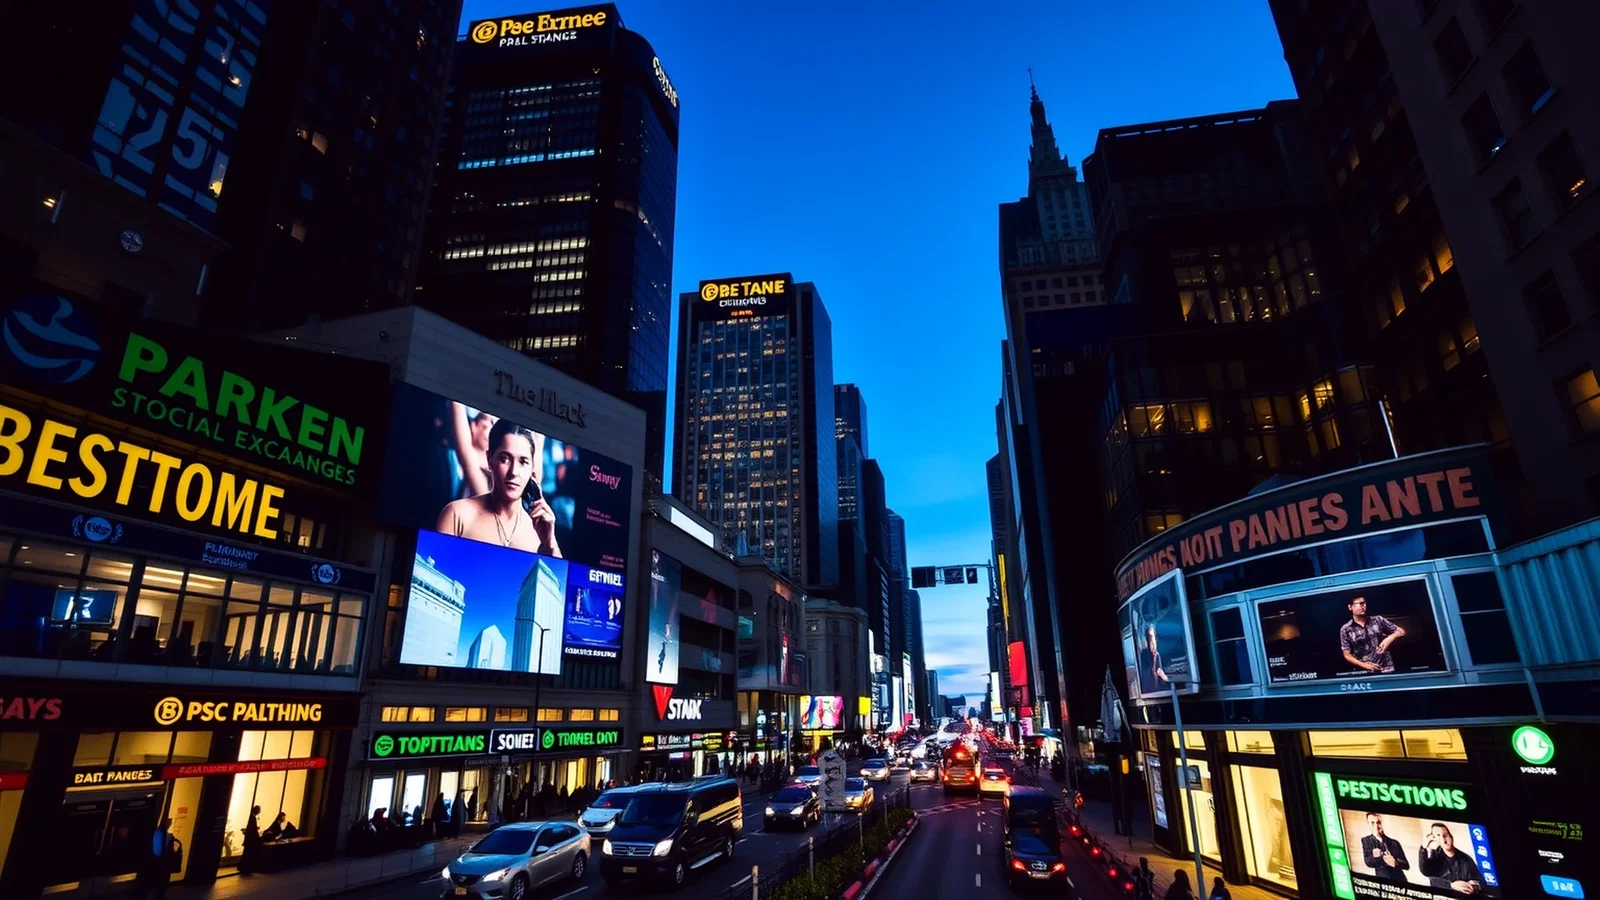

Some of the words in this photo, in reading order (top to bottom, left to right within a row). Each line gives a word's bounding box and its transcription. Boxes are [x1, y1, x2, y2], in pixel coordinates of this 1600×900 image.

[111, 387, 224, 442] STOCIAL
[235, 432, 355, 486] EXCAANGES
[118, 332, 365, 466] PARKEN
[0, 404, 285, 540] BESTTOME
[1229, 492, 1348, 553] PANIES
[1361, 466, 1481, 525] ANTE
[0, 697, 63, 721] AYS
[186, 701, 228, 722] PSC
[233, 702, 322, 722] PALTHING
